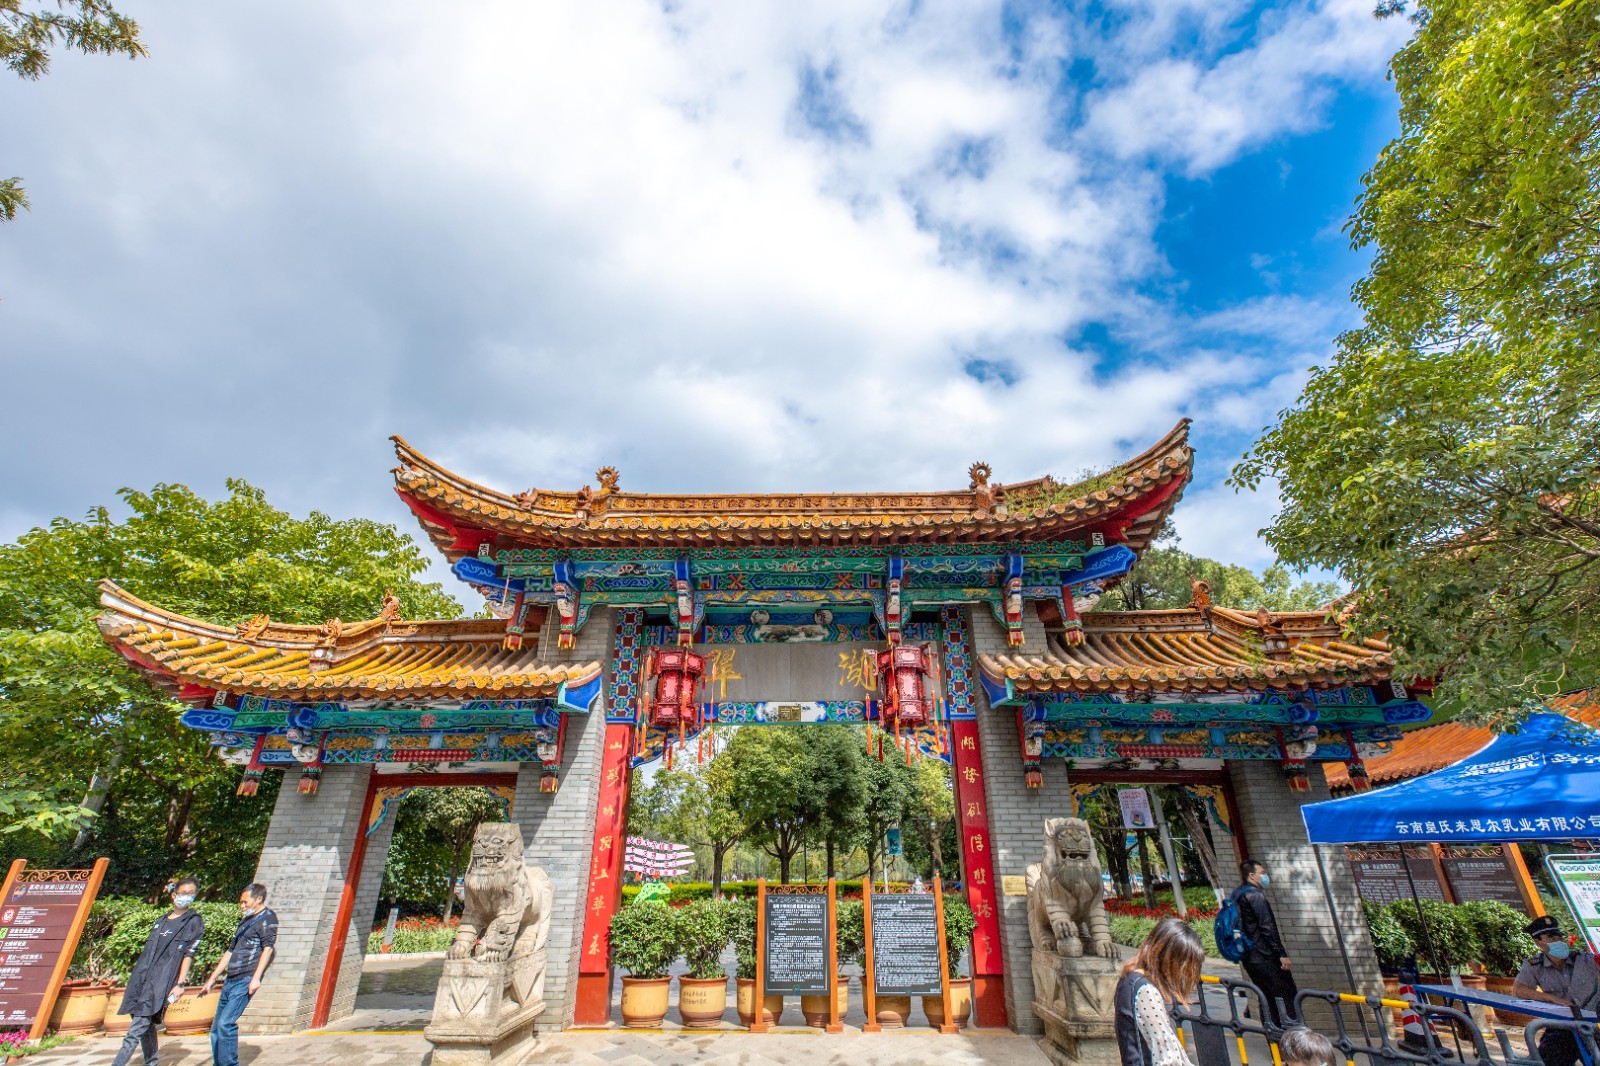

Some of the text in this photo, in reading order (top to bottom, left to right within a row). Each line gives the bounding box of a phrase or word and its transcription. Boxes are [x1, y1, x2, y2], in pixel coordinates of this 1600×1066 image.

[1395, 815, 1600, 834] 云南皇氏来思尔乳业有限公司
